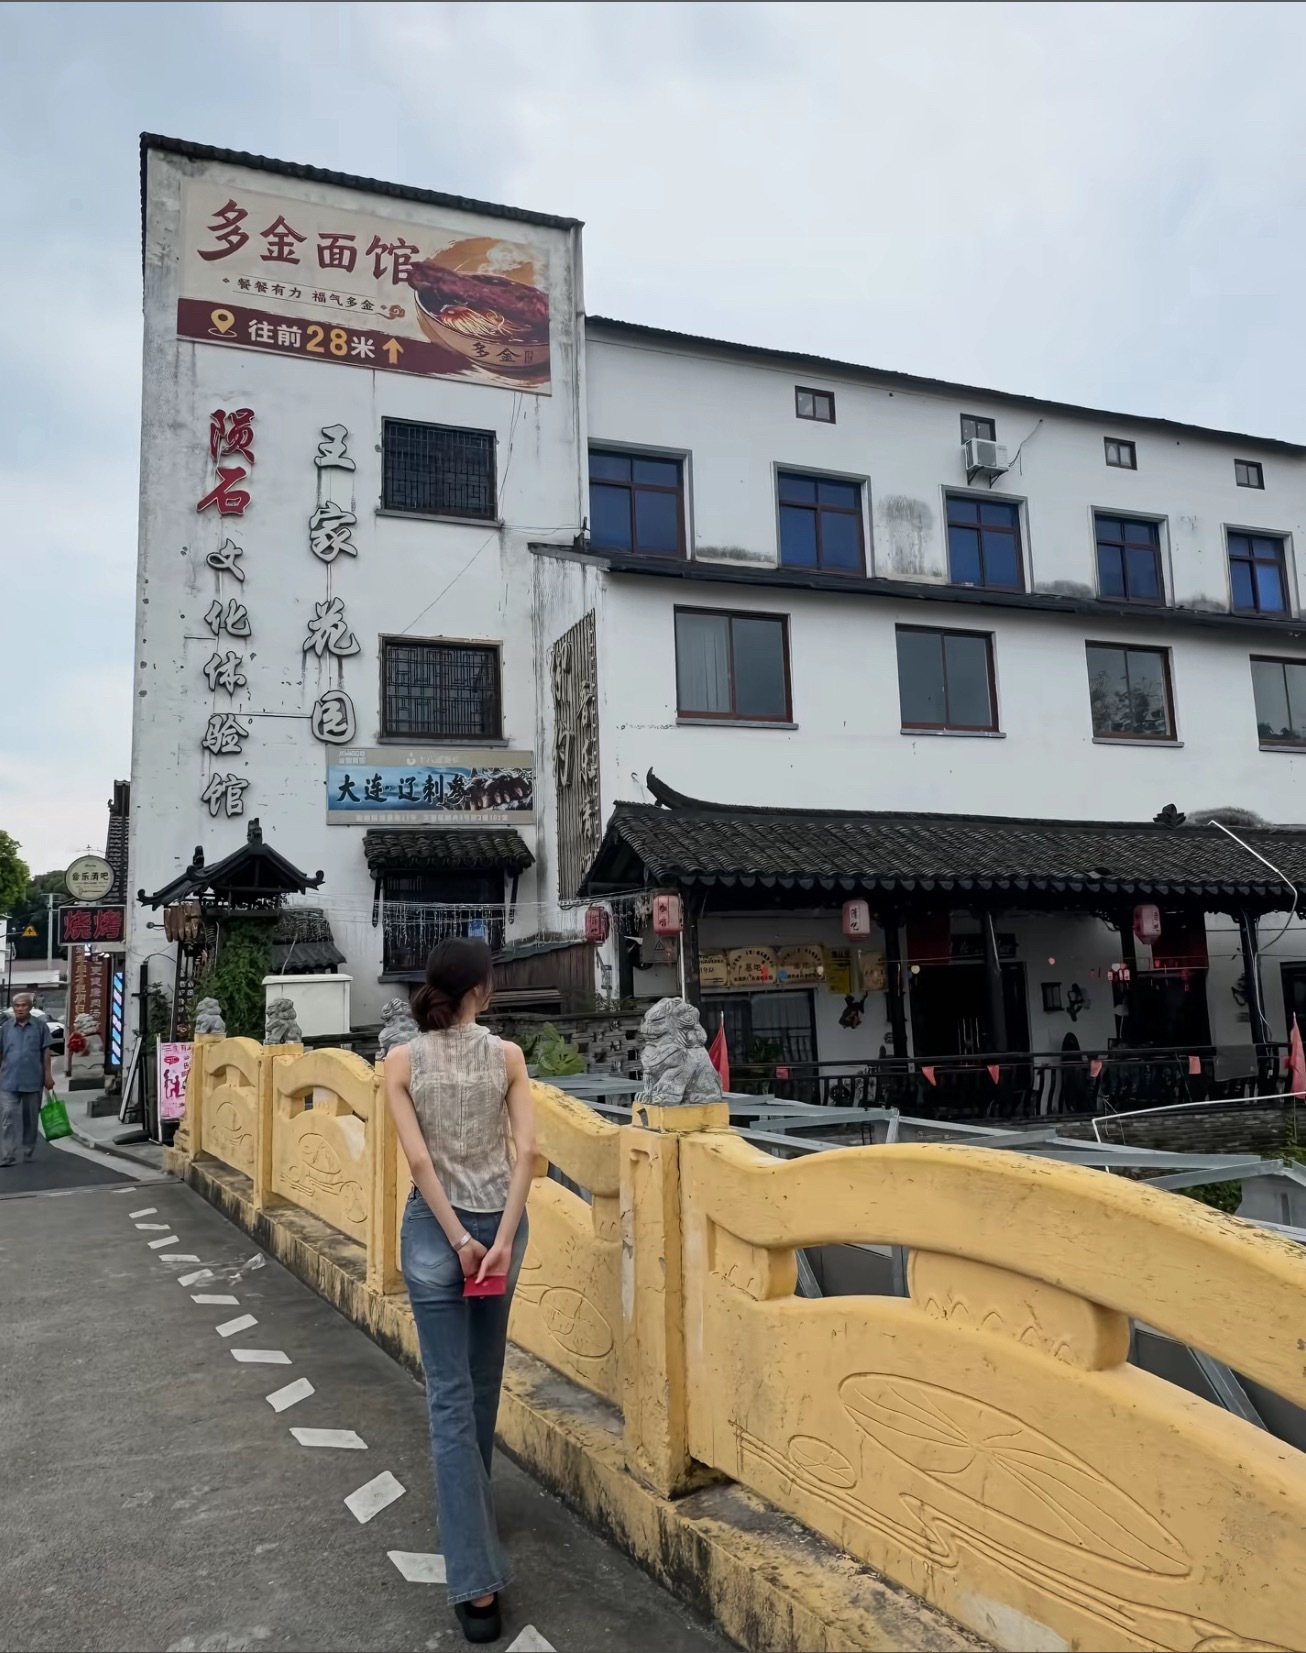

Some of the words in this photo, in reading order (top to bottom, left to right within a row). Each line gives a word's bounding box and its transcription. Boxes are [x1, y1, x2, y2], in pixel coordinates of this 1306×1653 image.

[197, 198, 421, 286] 多金面馆
[237, 277, 302, 300] 餐餐有力
[311, 290, 376, 312] 福气多金
[248, 318, 376, 360] 往前28米
[302, 423, 362, 745] 王家花园
[63, 909, 122, 941] 烧烤
